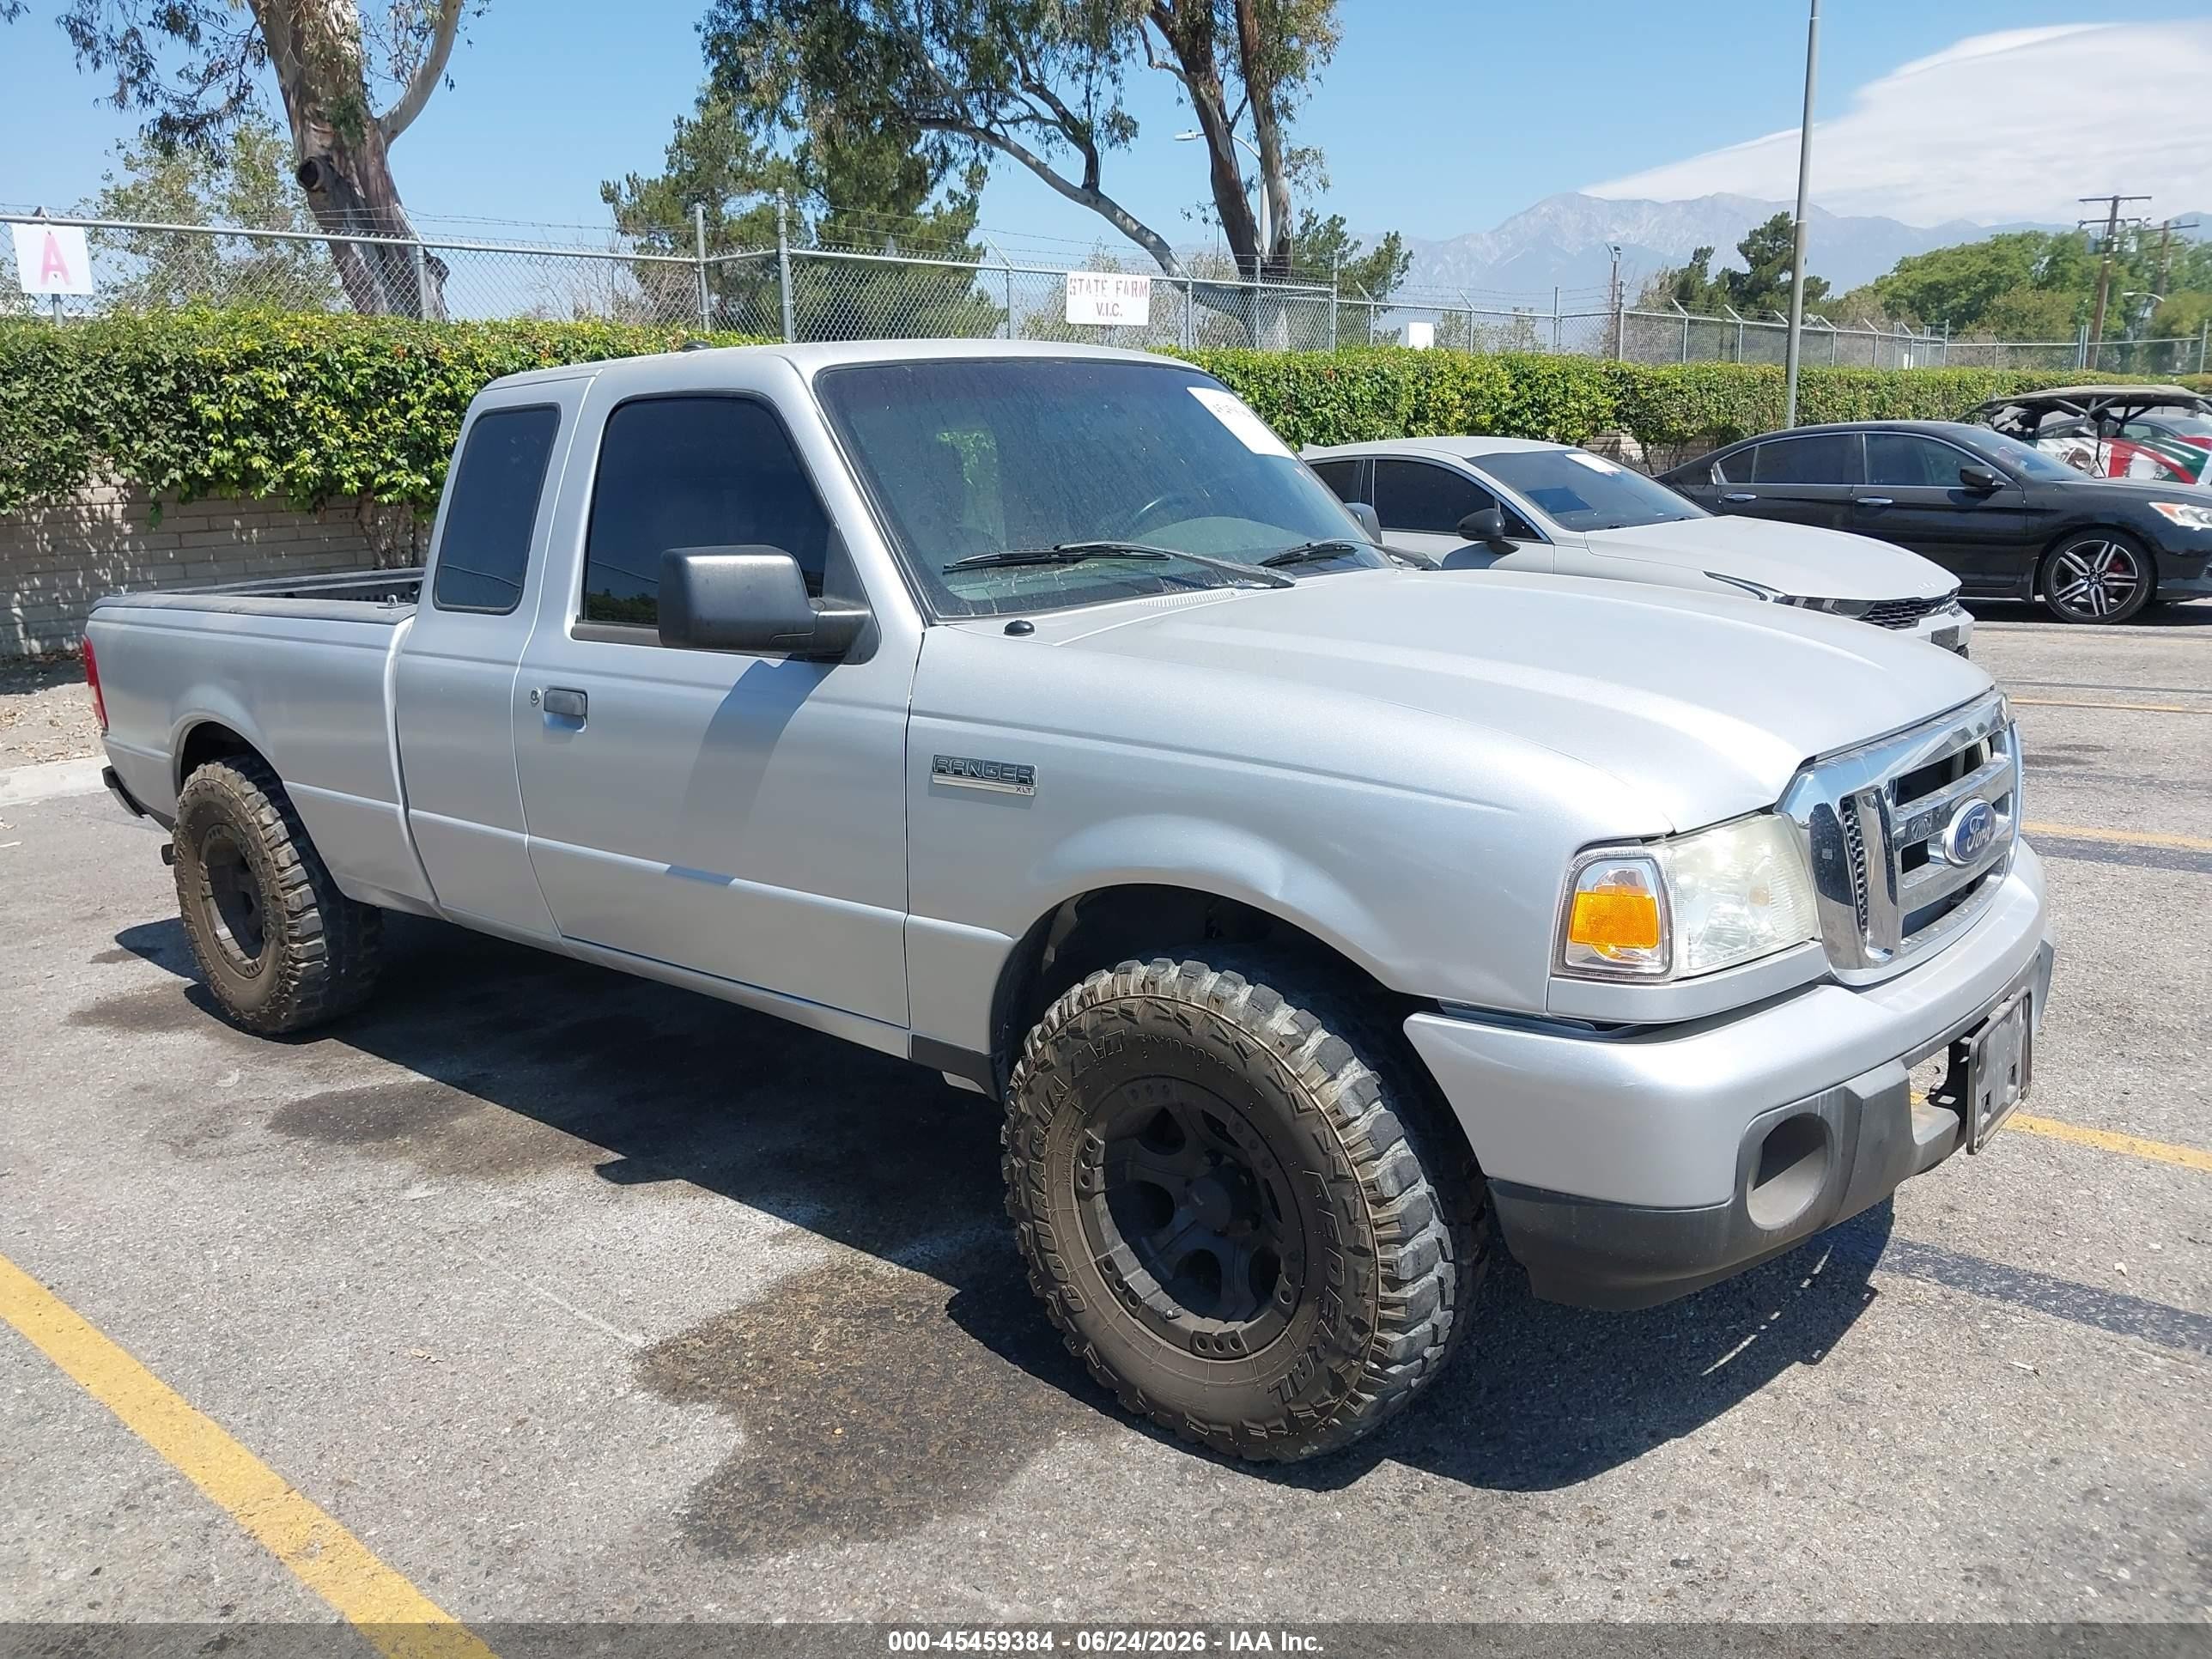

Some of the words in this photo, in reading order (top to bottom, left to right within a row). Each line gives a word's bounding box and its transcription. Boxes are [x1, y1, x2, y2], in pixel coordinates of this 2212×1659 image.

[40, 233, 72, 285] A
[1069, 277, 1108, 297] STATE
[1115, 280, 1148, 298] FARM
[1096, 302, 1123, 317] V.I.C.
[933, 756, 1035, 785] RANGER
[1016, 786, 1032, 794] XLT
[1966, 812, 1991, 853] Ford
